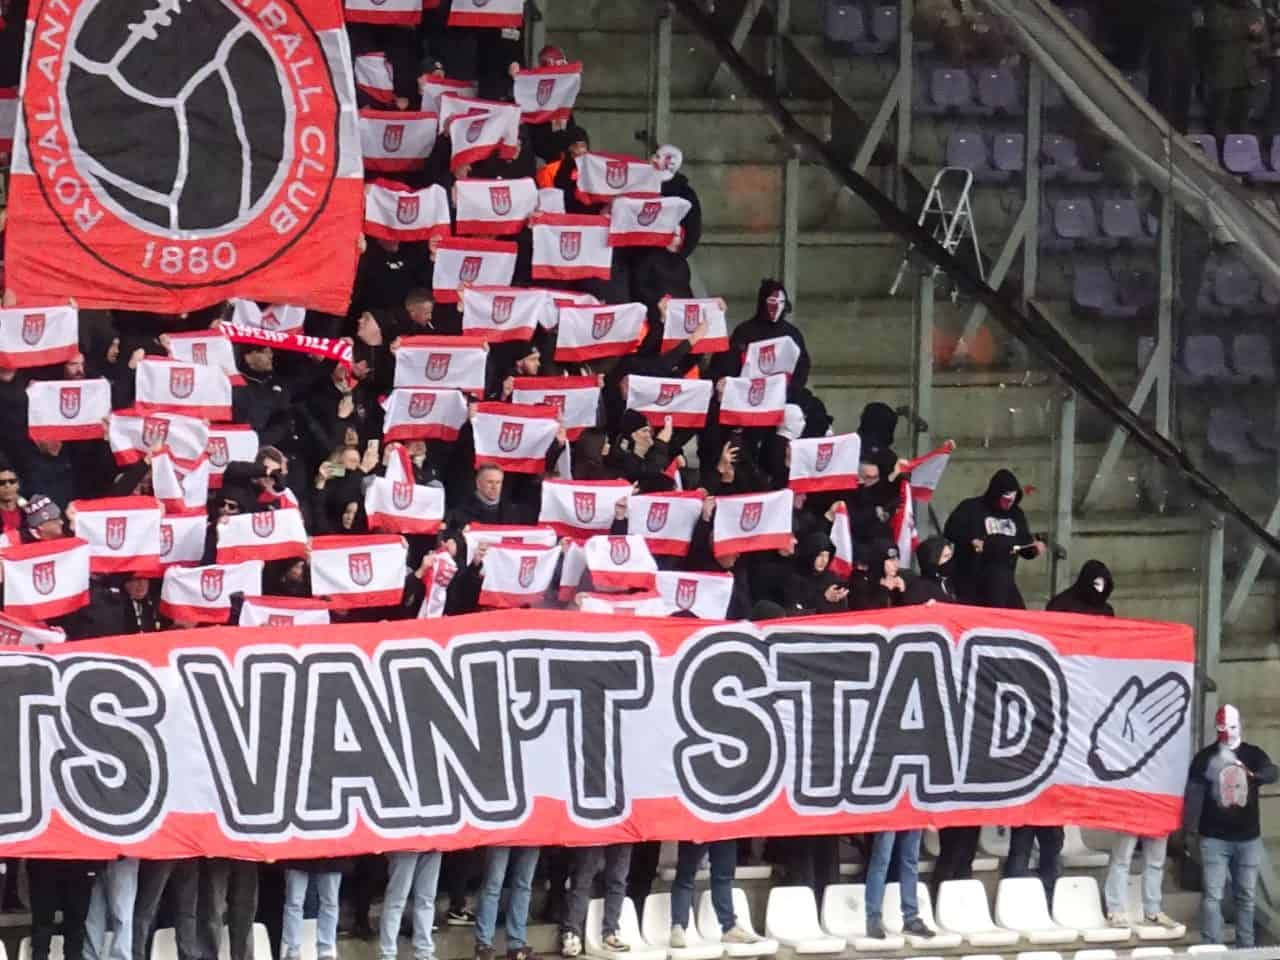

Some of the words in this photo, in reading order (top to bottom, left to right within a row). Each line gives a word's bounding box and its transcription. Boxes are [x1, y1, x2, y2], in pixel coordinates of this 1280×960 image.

[35, 97, 103, 232] ROYAL
[269, 128, 327, 235] CLUB
[142, 241, 238, 275] 1880
[177, 639, 652, 833] VAN'T
[673, 631, 1069, 814] STAD
